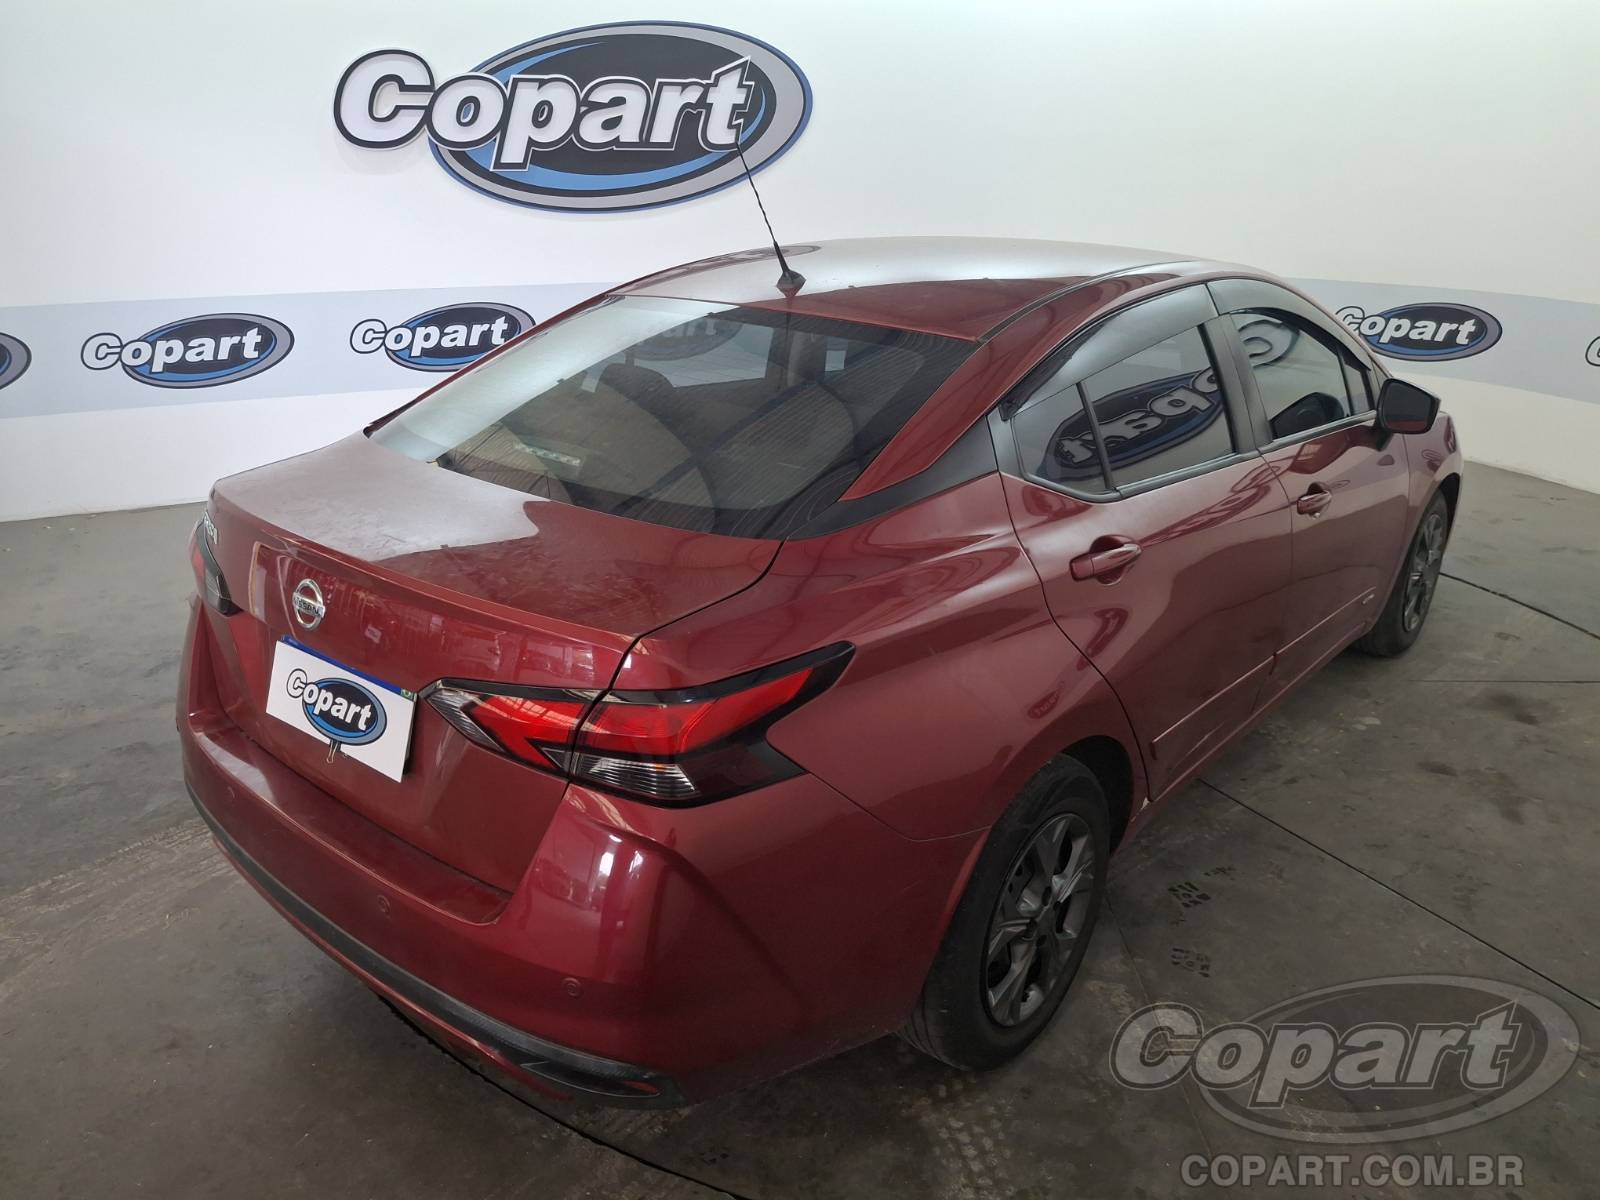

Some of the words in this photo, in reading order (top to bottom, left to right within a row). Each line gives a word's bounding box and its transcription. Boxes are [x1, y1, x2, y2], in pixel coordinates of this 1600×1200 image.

[334, 48, 754, 171] Copart
[82, 324, 262, 373] Copart
[350, 316, 509, 358] Copart
[1335, 305, 1477, 345] Copart
[287, 669, 372, 732] Copart
